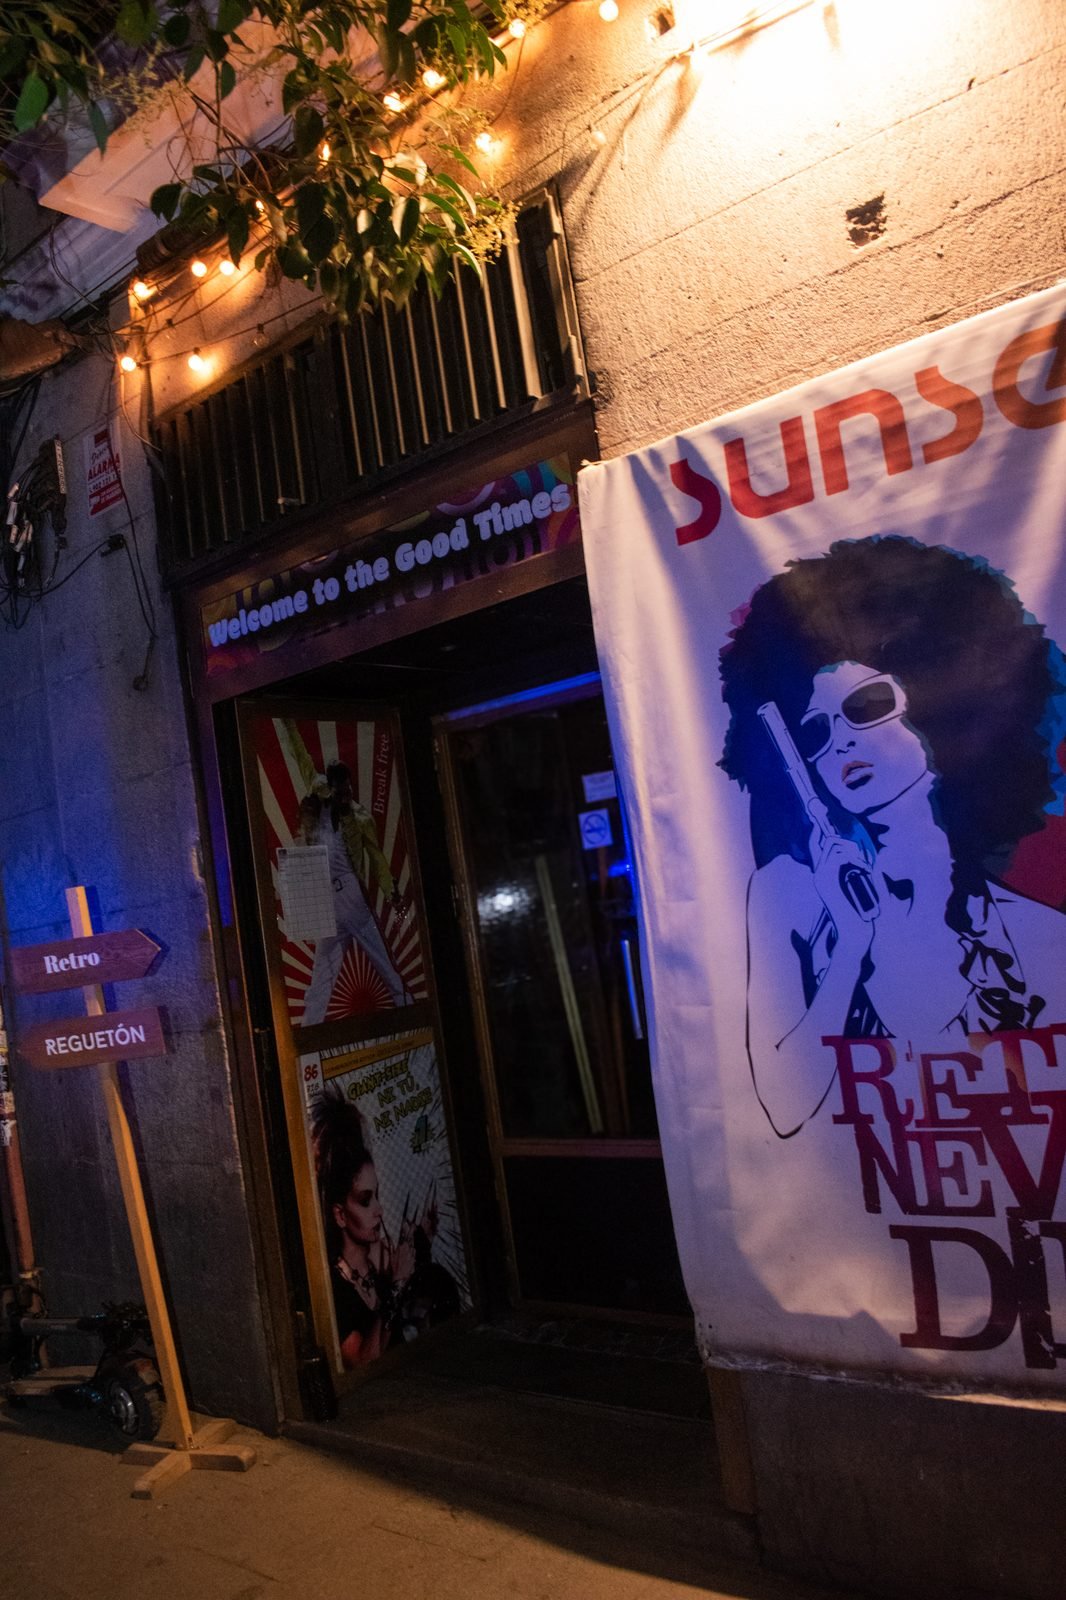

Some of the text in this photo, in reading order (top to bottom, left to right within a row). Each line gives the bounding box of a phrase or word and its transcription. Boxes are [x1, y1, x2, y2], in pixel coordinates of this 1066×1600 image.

[208, 483, 572, 647] Welcome to the Good Times
[374, 733, 390, 815] Break free
[43, 952, 100, 974] Retro
[45, 1023, 146, 1056] REGUETÓN
[304, 1064, 318, 1081] 86
[821, 1023, 1066, 1128] RET
[889, 1206, 1066, 1369] DI
